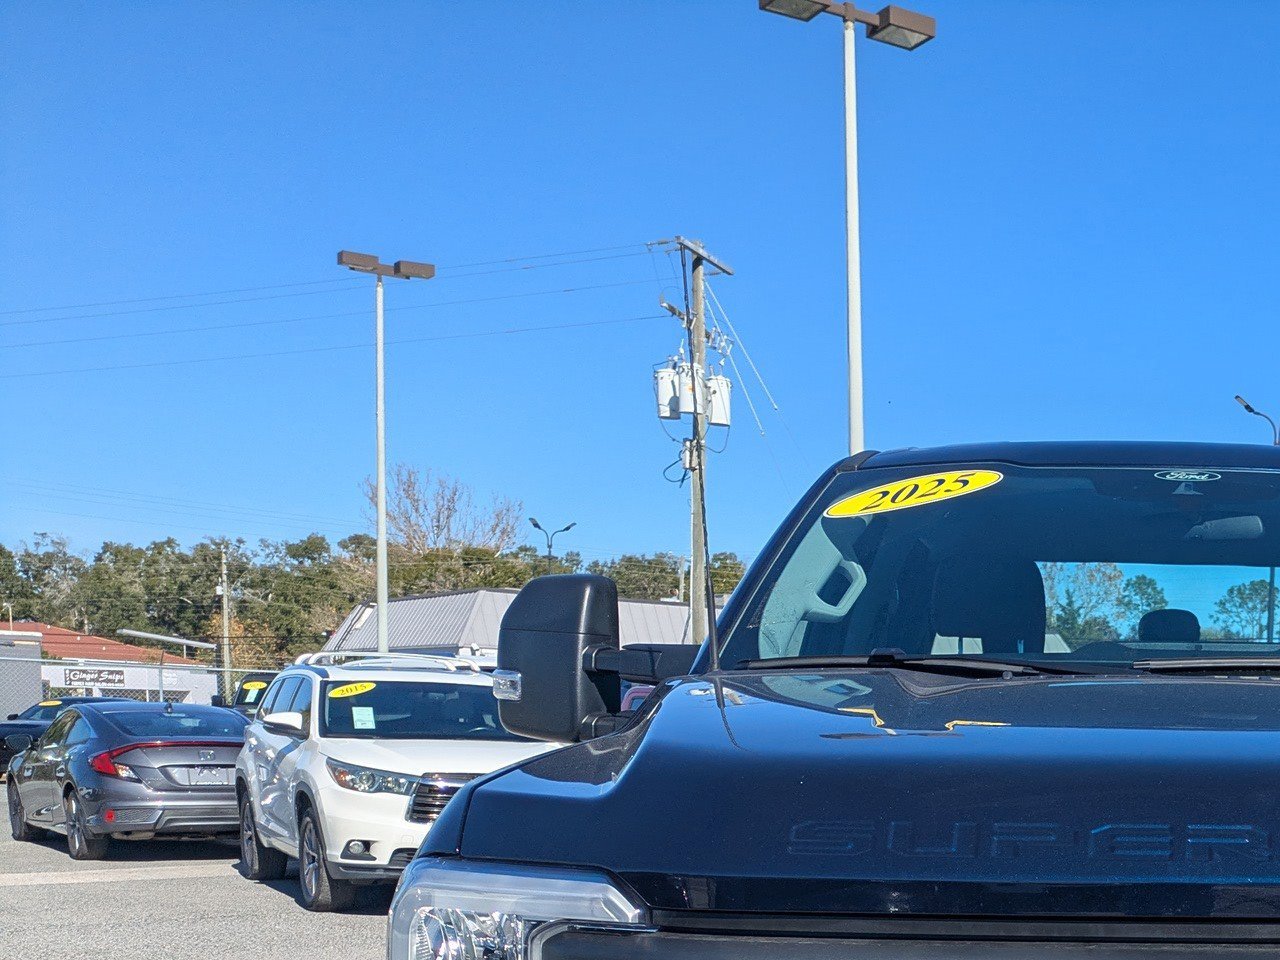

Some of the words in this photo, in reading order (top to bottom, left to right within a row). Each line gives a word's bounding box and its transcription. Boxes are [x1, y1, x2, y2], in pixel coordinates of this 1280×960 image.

[1165, 471, 1210, 480] Ford
[858, 472, 977, 512] 2025
[70, 671, 98, 681] Ginger
[340, 683, 367, 696] 2015
[785, 820, 1272, 862] SUPER
